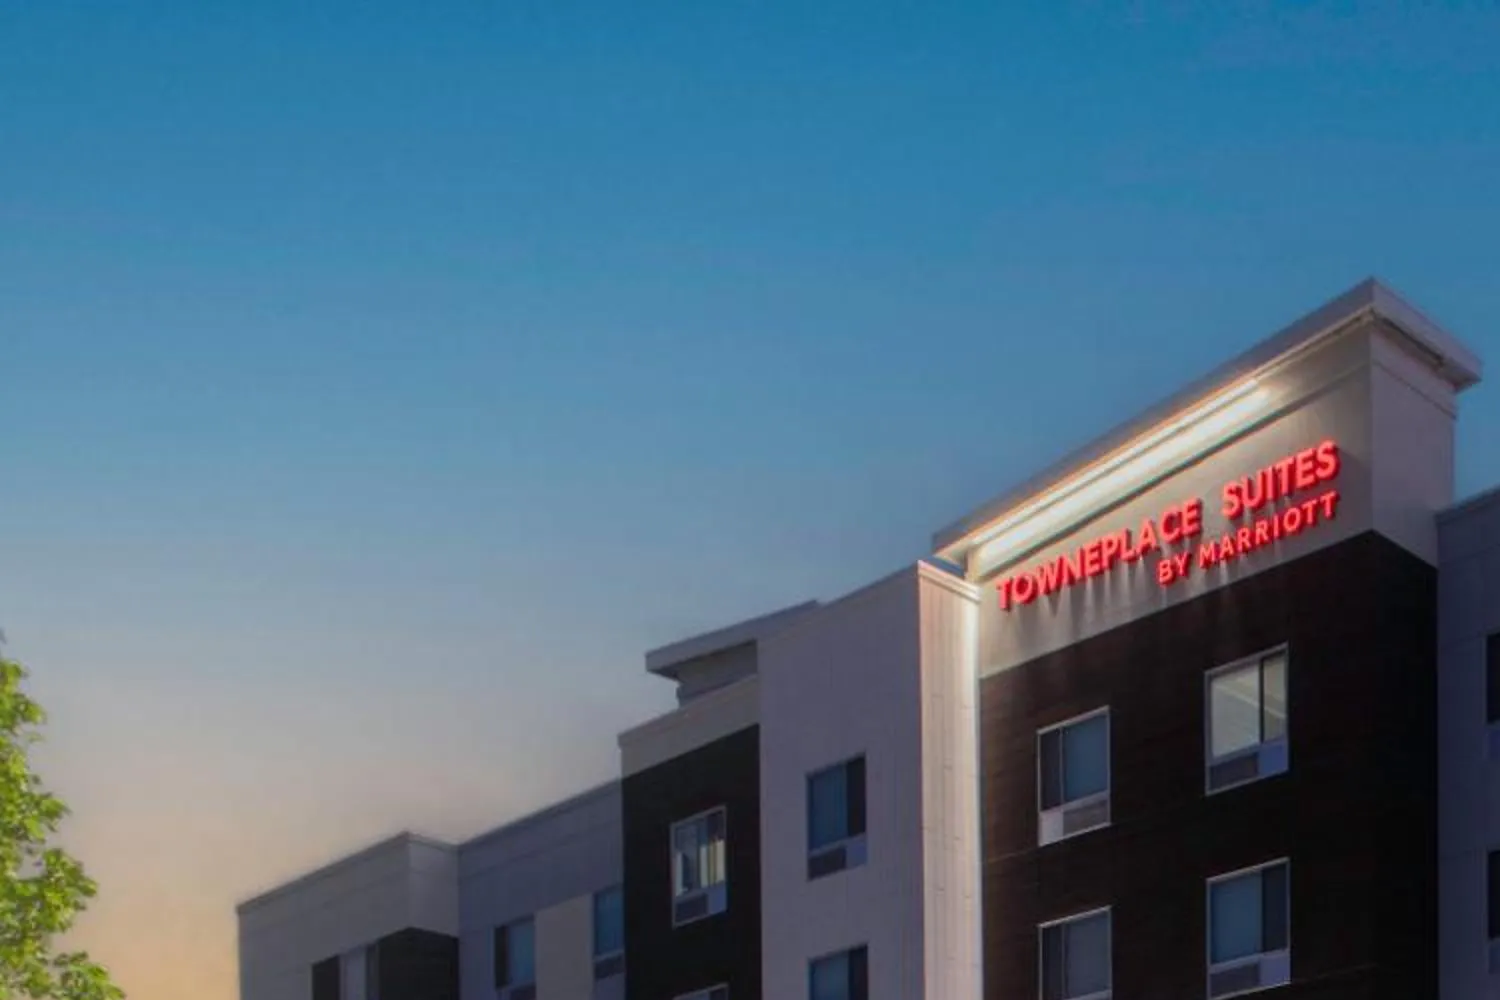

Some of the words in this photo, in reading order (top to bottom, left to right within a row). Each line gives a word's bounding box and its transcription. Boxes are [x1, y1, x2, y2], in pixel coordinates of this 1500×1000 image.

[996, 496, 1202, 611] TOWNEPLACE
[1220, 438, 1339, 520] SUITES
[1156, 549, 1190, 589] BY
[1197, 490, 1338, 570] MARRIOTT
